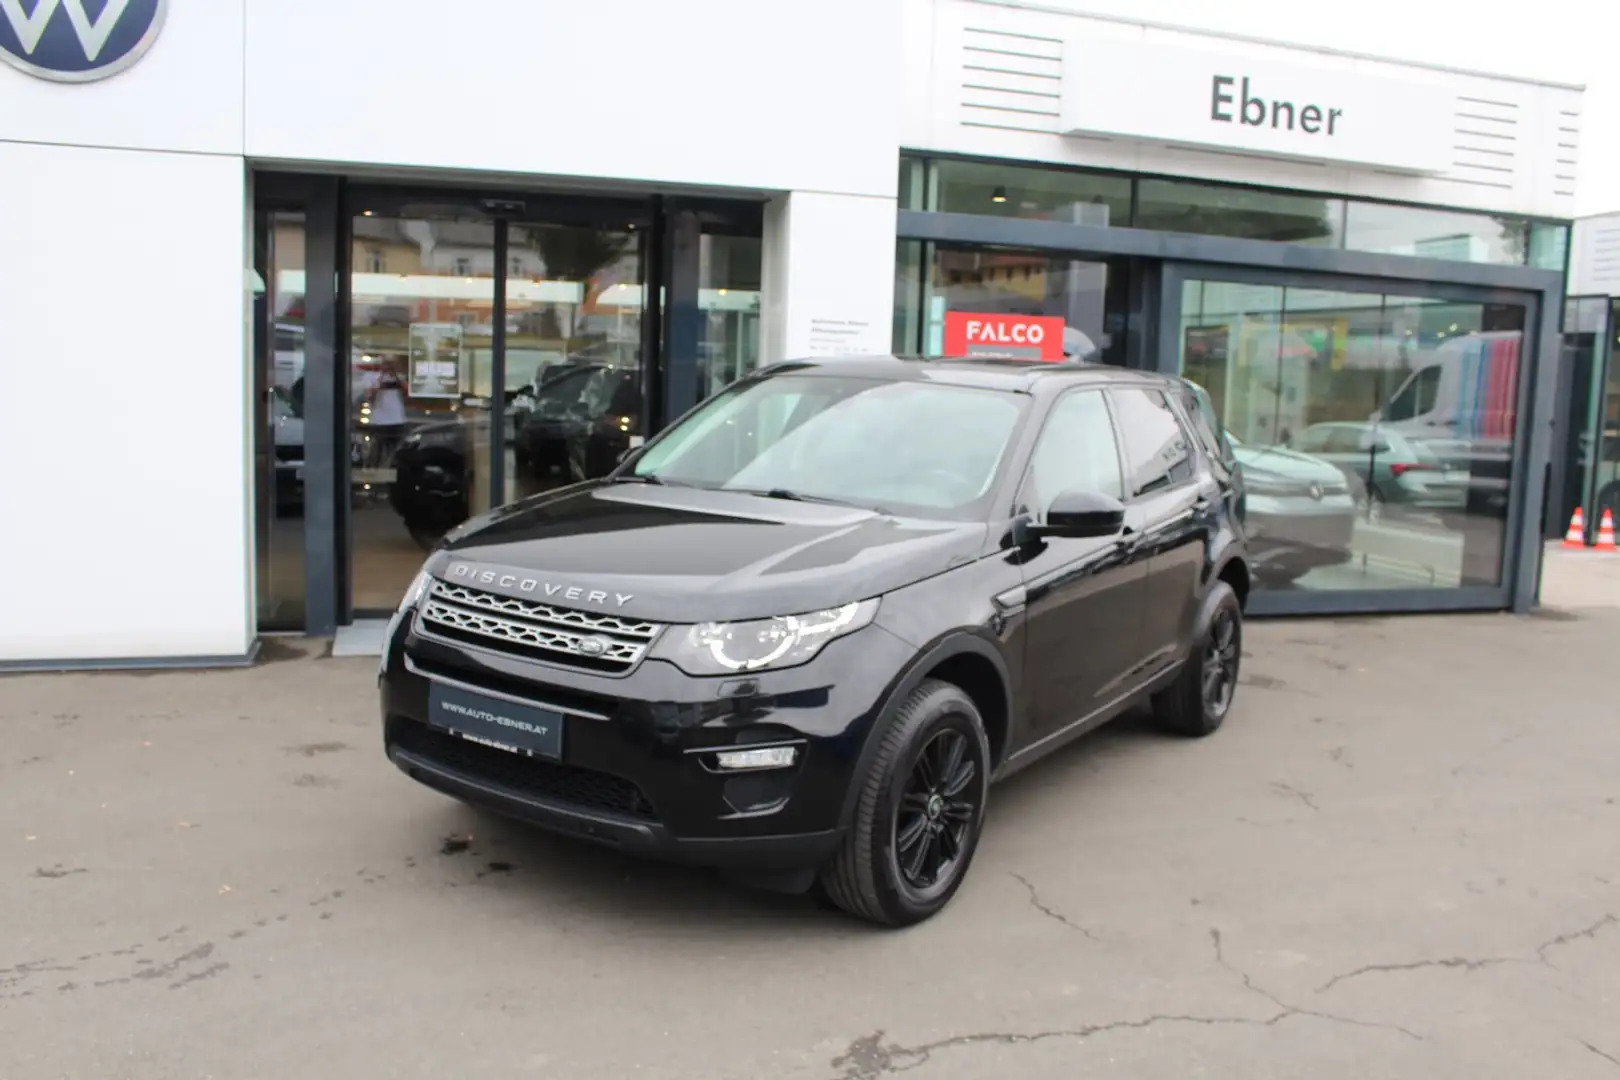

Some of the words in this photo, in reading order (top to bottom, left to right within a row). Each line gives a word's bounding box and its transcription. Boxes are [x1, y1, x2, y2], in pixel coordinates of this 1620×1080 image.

[1211, 74, 1342, 136] Ebner
[966, 320, 1045, 344] FALCO
[454, 564, 634, 607] DISCOVERY
[441, 700, 549, 736] WWW.AUTO-EBNER.AT
